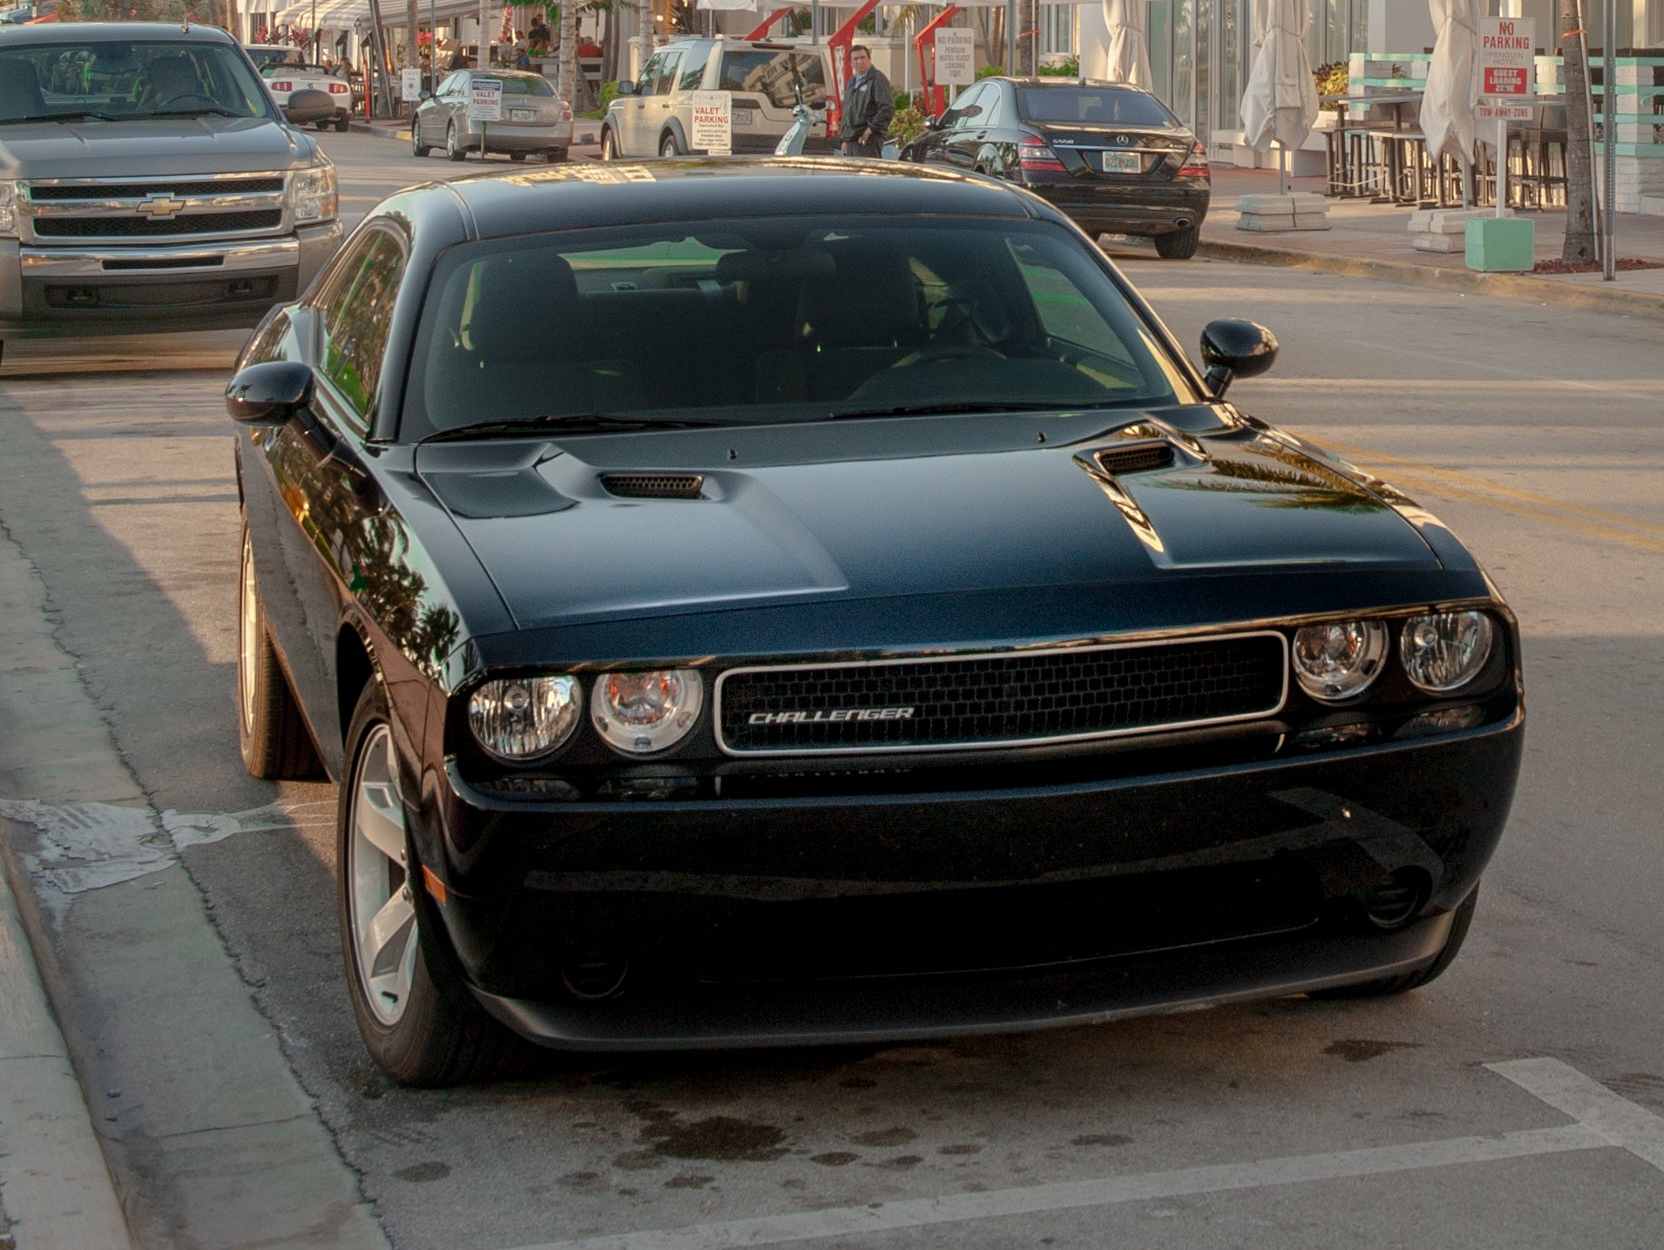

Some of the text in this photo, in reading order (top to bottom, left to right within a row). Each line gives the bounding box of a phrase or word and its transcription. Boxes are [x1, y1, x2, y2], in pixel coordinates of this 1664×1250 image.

[1499, 22, 1514, 35] NO
[937, 36, 972, 45] NO PARKING
[1483, 36, 1530, 50] PARKING
[944, 46, 966, 54] PENGUIN
[939, 54, 971, 62] HOTEL GUEST
[1489, 51, 1524, 59] PENGUIN
[944, 62, 966, 70] LOADING
[1493, 69, 1518, 77] GUEST
[1489, 76, 1522, 85] LOADING
[472, 98, 498, 106] PARKING
[695, 106, 720, 115] VALET
[694, 115, 729, 124] PARKING
[748, 707, 914, 725] CHALLENGER
